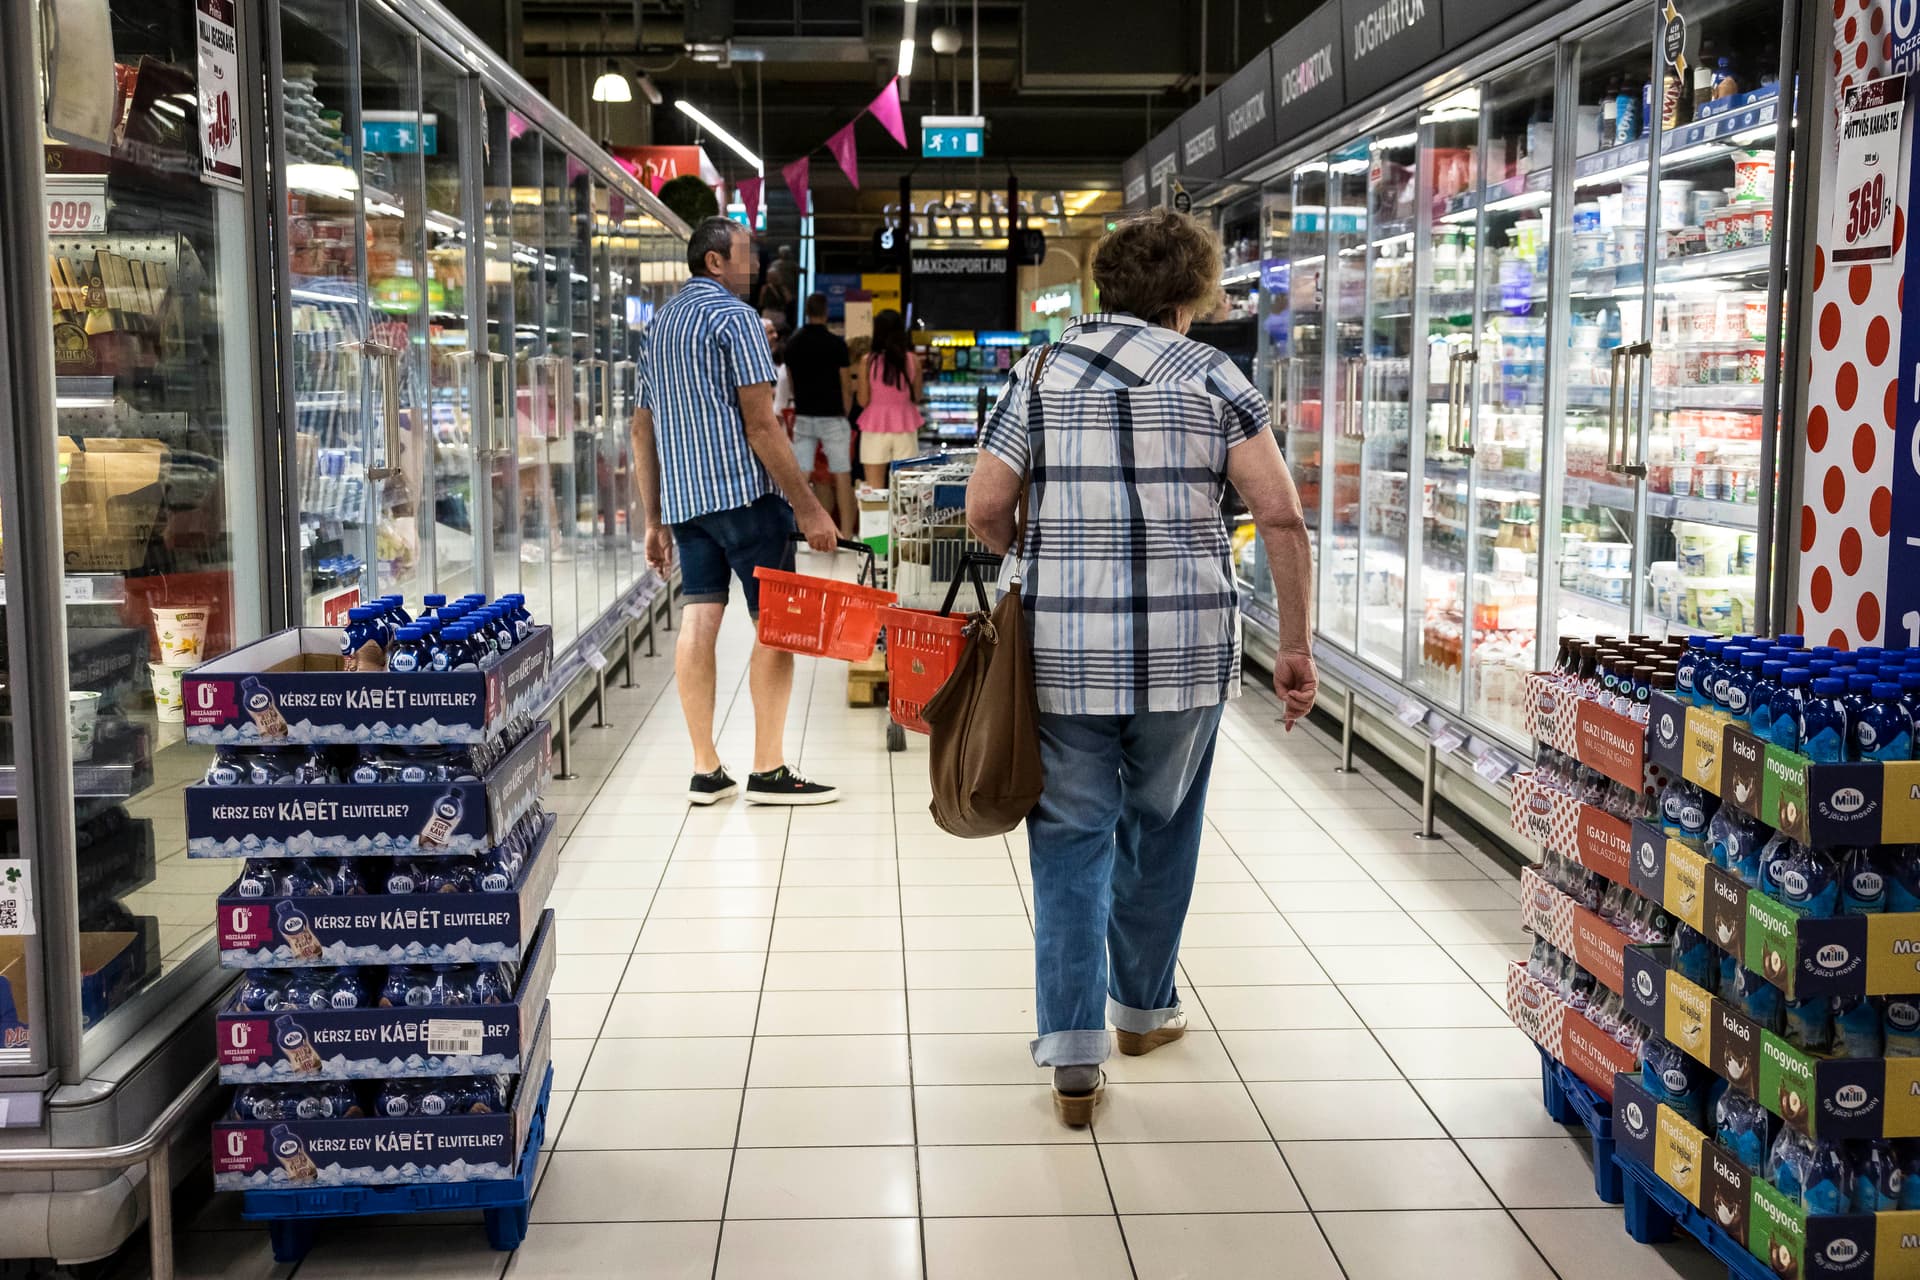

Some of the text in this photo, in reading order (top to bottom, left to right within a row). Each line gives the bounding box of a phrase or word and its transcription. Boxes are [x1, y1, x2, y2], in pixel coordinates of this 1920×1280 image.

[1281, 44, 1333, 107] JOGHURTOK
[1844, 113, 1869, 140] PÖTTYÖS
[1869, 107, 1889, 136] KAKAÓS
[48, 201, 91, 229] 999
[1845, 172, 1891, 243] 369 Ft
[881, 233, 894, 249] 9
[912, 257, 1007, 273] MAXCSOPORT.HU
[280, 691, 317, 707] KÉRSZ
[320, 694, 342, 707] EGY
[410, 693, 477, 706] ELVITELRE?
[1582, 720, 1599, 737] IGAZI
[1601, 725, 1635, 755] ÚTRAVALÓ
[1733, 738, 1756, 761] kakaó
[216, 772, 233, 780] Milli
[1834, 793, 1860, 806] Milli
[212, 804, 249, 819] KÉRSZ
[253, 806, 275, 819] EGY
[342, 804, 409, 818] ELVITELRE?
[1586, 824, 1631, 853] IGAZI ÚTRA
[241, 883, 261, 895] Milli
[390, 879, 412, 891] Milli
[484, 878, 506, 890] Milli
[1714, 878, 1738, 905] kakaó
[1856, 878, 1880, 890] Milli
[314, 914, 351, 929] KÉRSZ
[354, 915, 377, 928] EGY
[443, 912, 510, 926] ELVITELRE?
[1749, 903, 1791, 937] mogyoró-
[1580, 926, 1624, 965] IGAZI ÚTRAVA
[1820, 950, 1845, 963] Milli
[1891, 1008, 1915, 1021] Milli
[1723, 1012, 1750, 1041] kakaó
[314, 1028, 351, 1043] KÉRSZ
[354, 1029, 377, 1042] EGY
[1569, 1029, 1587, 1050] IGAZI
[1764, 1041, 1813, 1079] mogyoró-
[1665, 1074, 1685, 1087] Milli
[1839, 1091, 1864, 1102] Milli
[309, 1137, 346, 1152] KÉRSZ
[350, 1138, 371, 1151] EGY
[438, 1134, 504, 1148] ELVITELRE?
[1713, 1156, 1741, 1189] kakaó
[1754, 1191, 1803, 1234] mogyoró-
[1830, 1245, 1854, 1257] Milli
